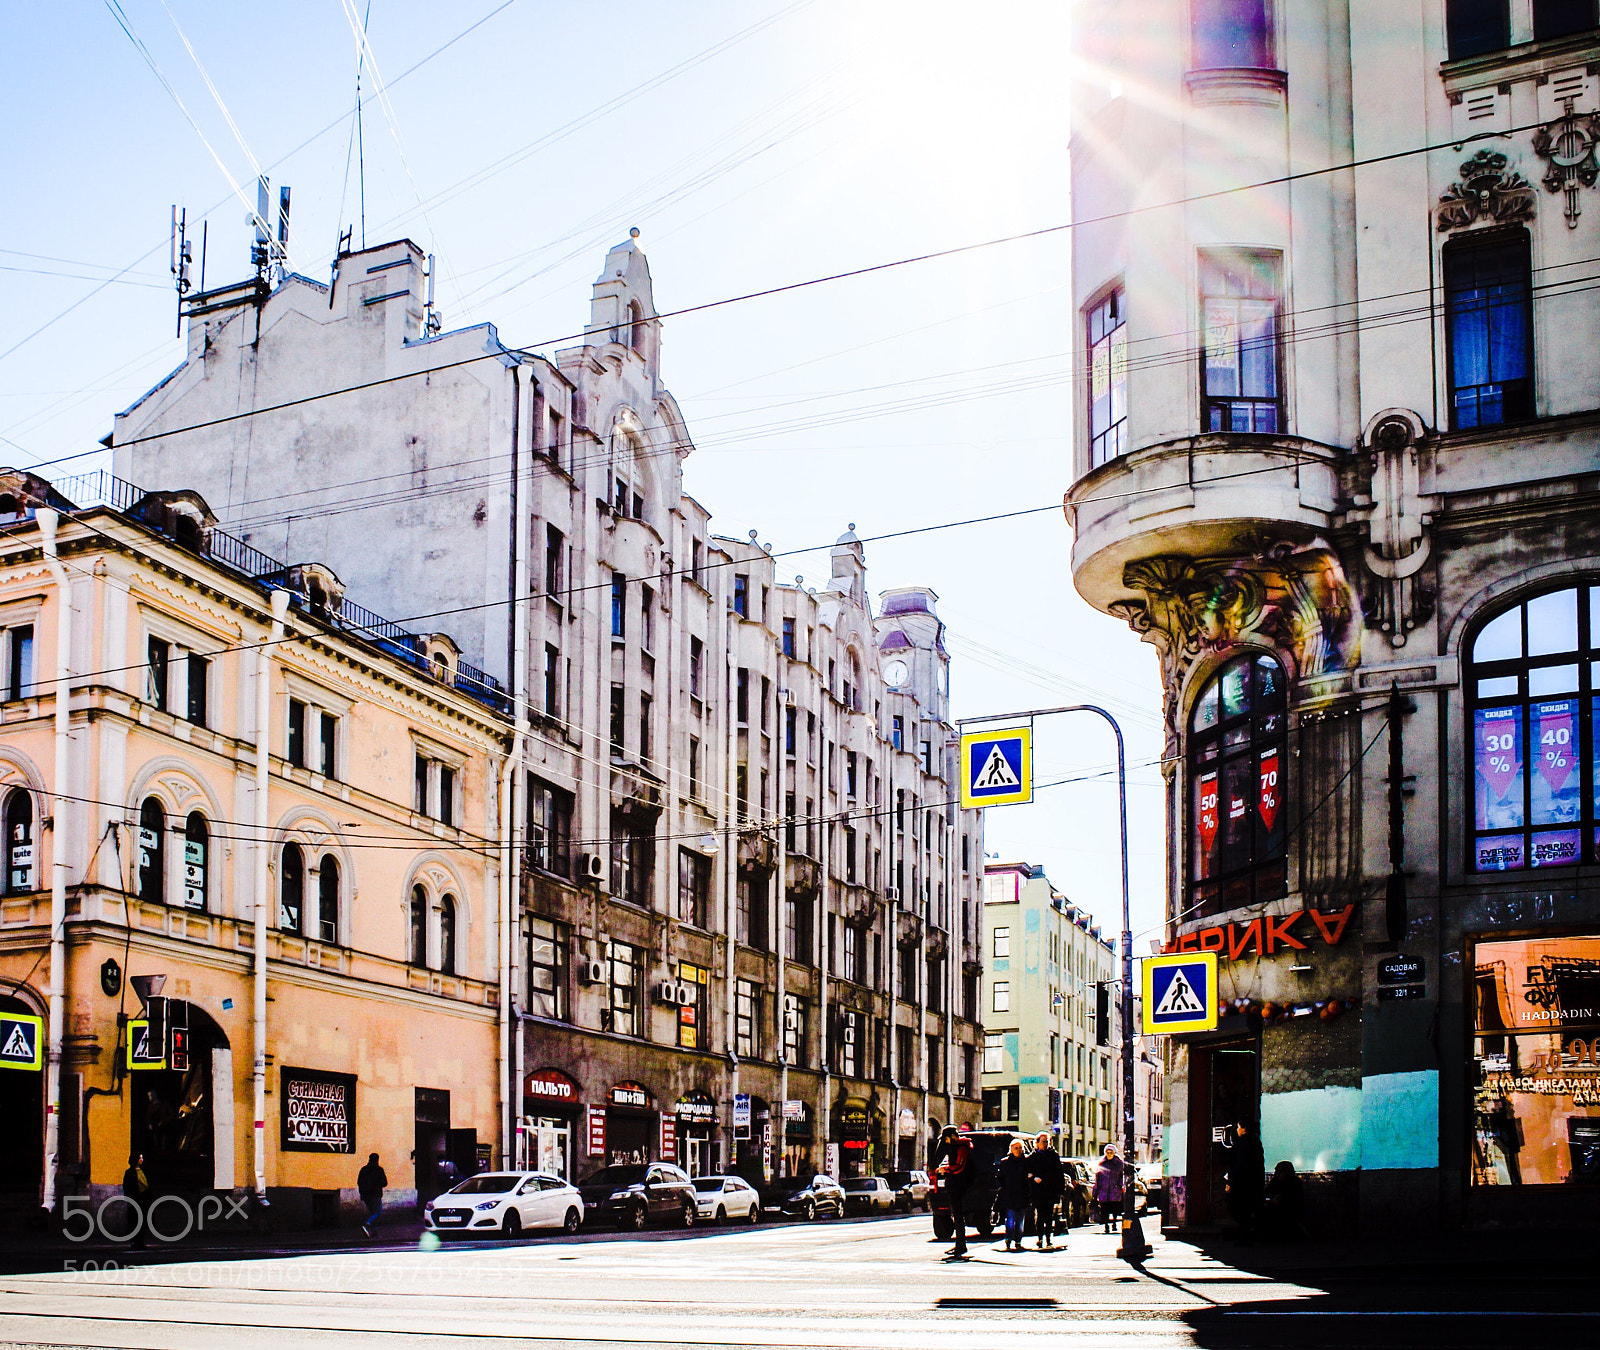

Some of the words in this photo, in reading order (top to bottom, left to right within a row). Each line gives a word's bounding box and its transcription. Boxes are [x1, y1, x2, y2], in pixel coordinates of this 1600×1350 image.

[1209, 326, 1228, 336] 407
[1206, 359, 1234, 368] SALE
[1486, 733, 1514, 752] 30
[1541, 728, 1569, 746] 40
[1260, 770, 1277, 790] 70
[1201, 793, 1217, 811] 50
[185, 878, 201, 886] МОНТ
[1385, 963, 1418, 972] САДОВАЯ
[1395, 989, 1408, 997] 32/1
[1522, 1008, 1592, 1021] HADDADIN
[288, 1080, 345, 1101] СТИЛЬНАЯ
[531, 1080, 571, 1097] ПАЛЬТО
[289, 1099, 346, 1121] ОДЕЖДА
[736, 1101, 749, 1110] AIR
[295, 1119, 347, 1139] СУМКИ
[763, 1125, 771, 1164] КЛЮЧИ
